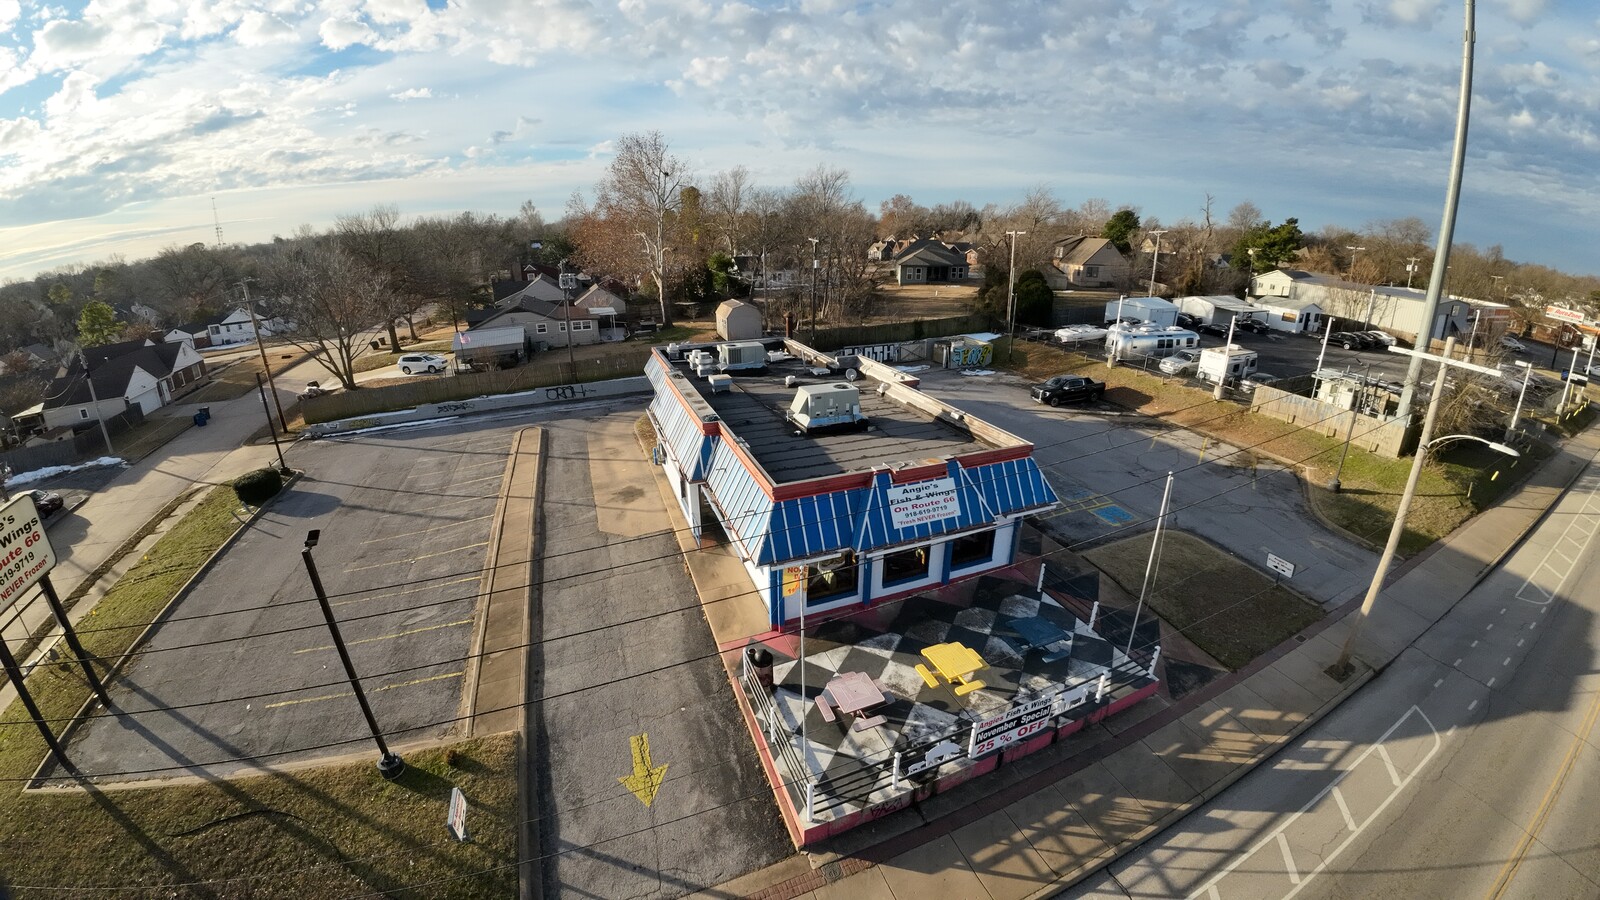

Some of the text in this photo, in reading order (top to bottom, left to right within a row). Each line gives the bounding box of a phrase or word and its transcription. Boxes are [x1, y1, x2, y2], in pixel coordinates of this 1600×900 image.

[890, 496, 911, 505] Fish
[925, 489, 955, 498] Wings
[902, 483, 939, 494] Angie's
[904, 505, 948, 518] 918-619-9719
[911, 500, 941, 509] Route
[897, 510, 957, 526] "Fresh NEVER Frozen"
[0, 517, 39, 549] Wings
[24, 530, 41, 548] 66
[0, 551, 36, 586] 619-9719
[1, 554, 49, 602] NEVER Frozen"
[976, 706, 1051, 741] November Special
[978, 696, 1052, 730] Angies Fish & Wings
[976, 719, 1046, 755] 25 % OFF
